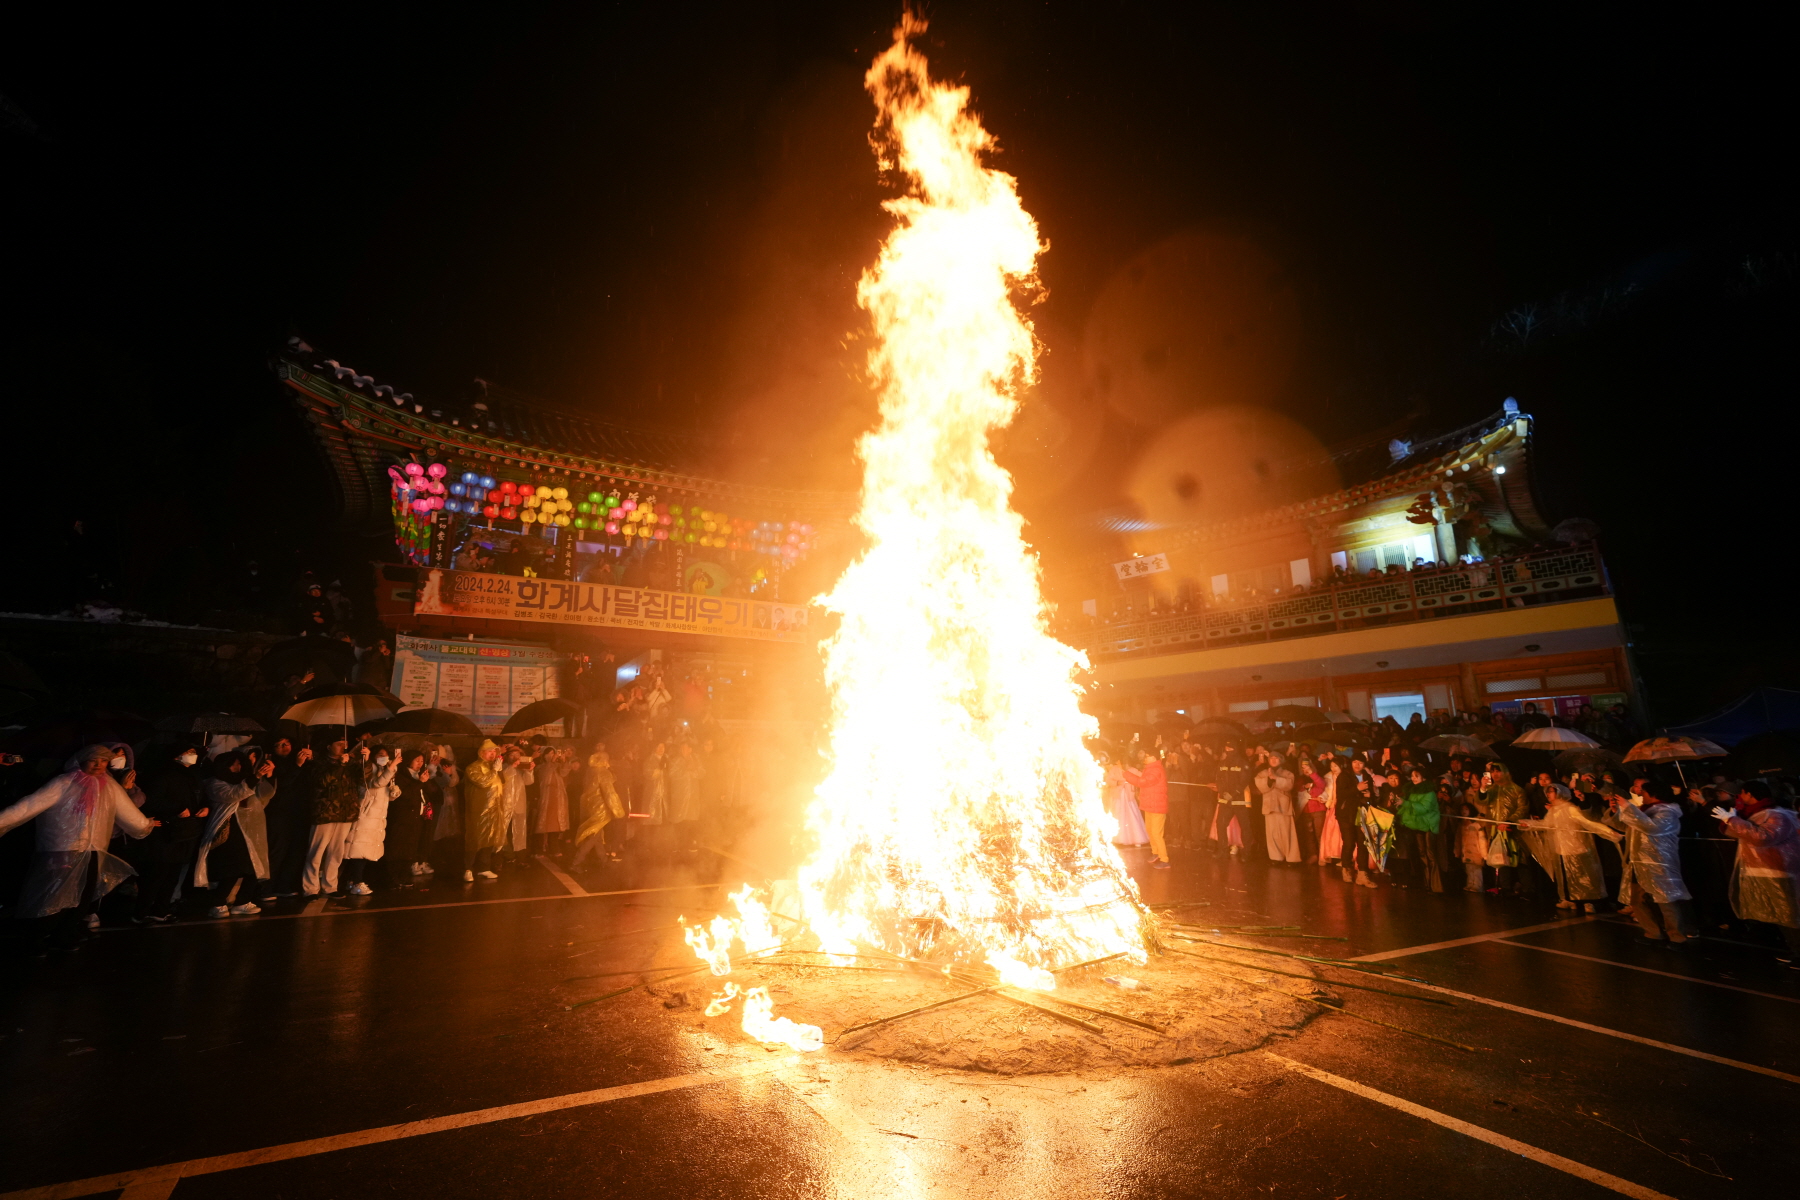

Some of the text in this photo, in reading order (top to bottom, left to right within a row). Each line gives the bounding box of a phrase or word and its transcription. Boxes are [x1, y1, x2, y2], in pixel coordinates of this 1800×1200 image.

[455, 574, 514, 595] 2024.2.24.
[453, 594, 511, 607] 토요일 오후 6시 30분
[515, 579, 748, 627] 화계사 달집태우기
[514, 610, 533, 618] 김병조
[410, 643, 438, 652] 화계사
[441, 645, 477, 655] 불교대학
[1566, 699, 1582, 707] 불교
